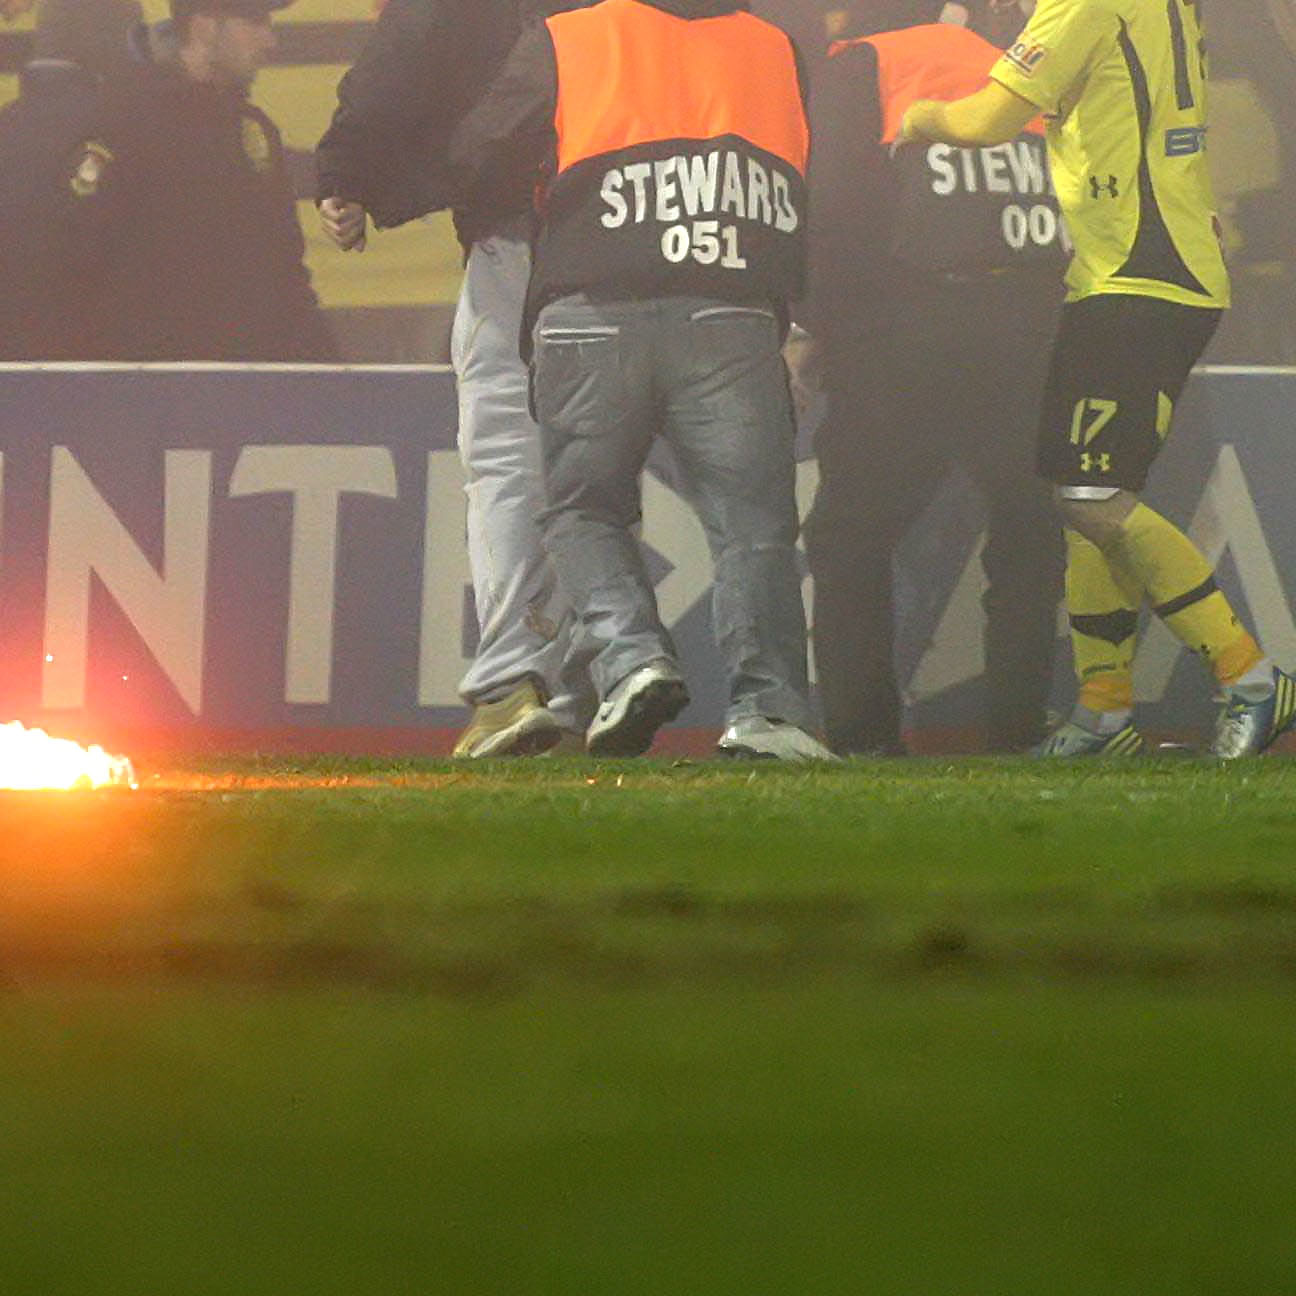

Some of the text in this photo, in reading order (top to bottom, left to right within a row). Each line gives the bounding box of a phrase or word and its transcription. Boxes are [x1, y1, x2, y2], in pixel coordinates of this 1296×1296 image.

[600, 151, 798, 233] STEWARD
[926, 142, 1056, 198] STEW
[661, 220, 746, 270] 051
[1070, 398, 1118, 446] 17
